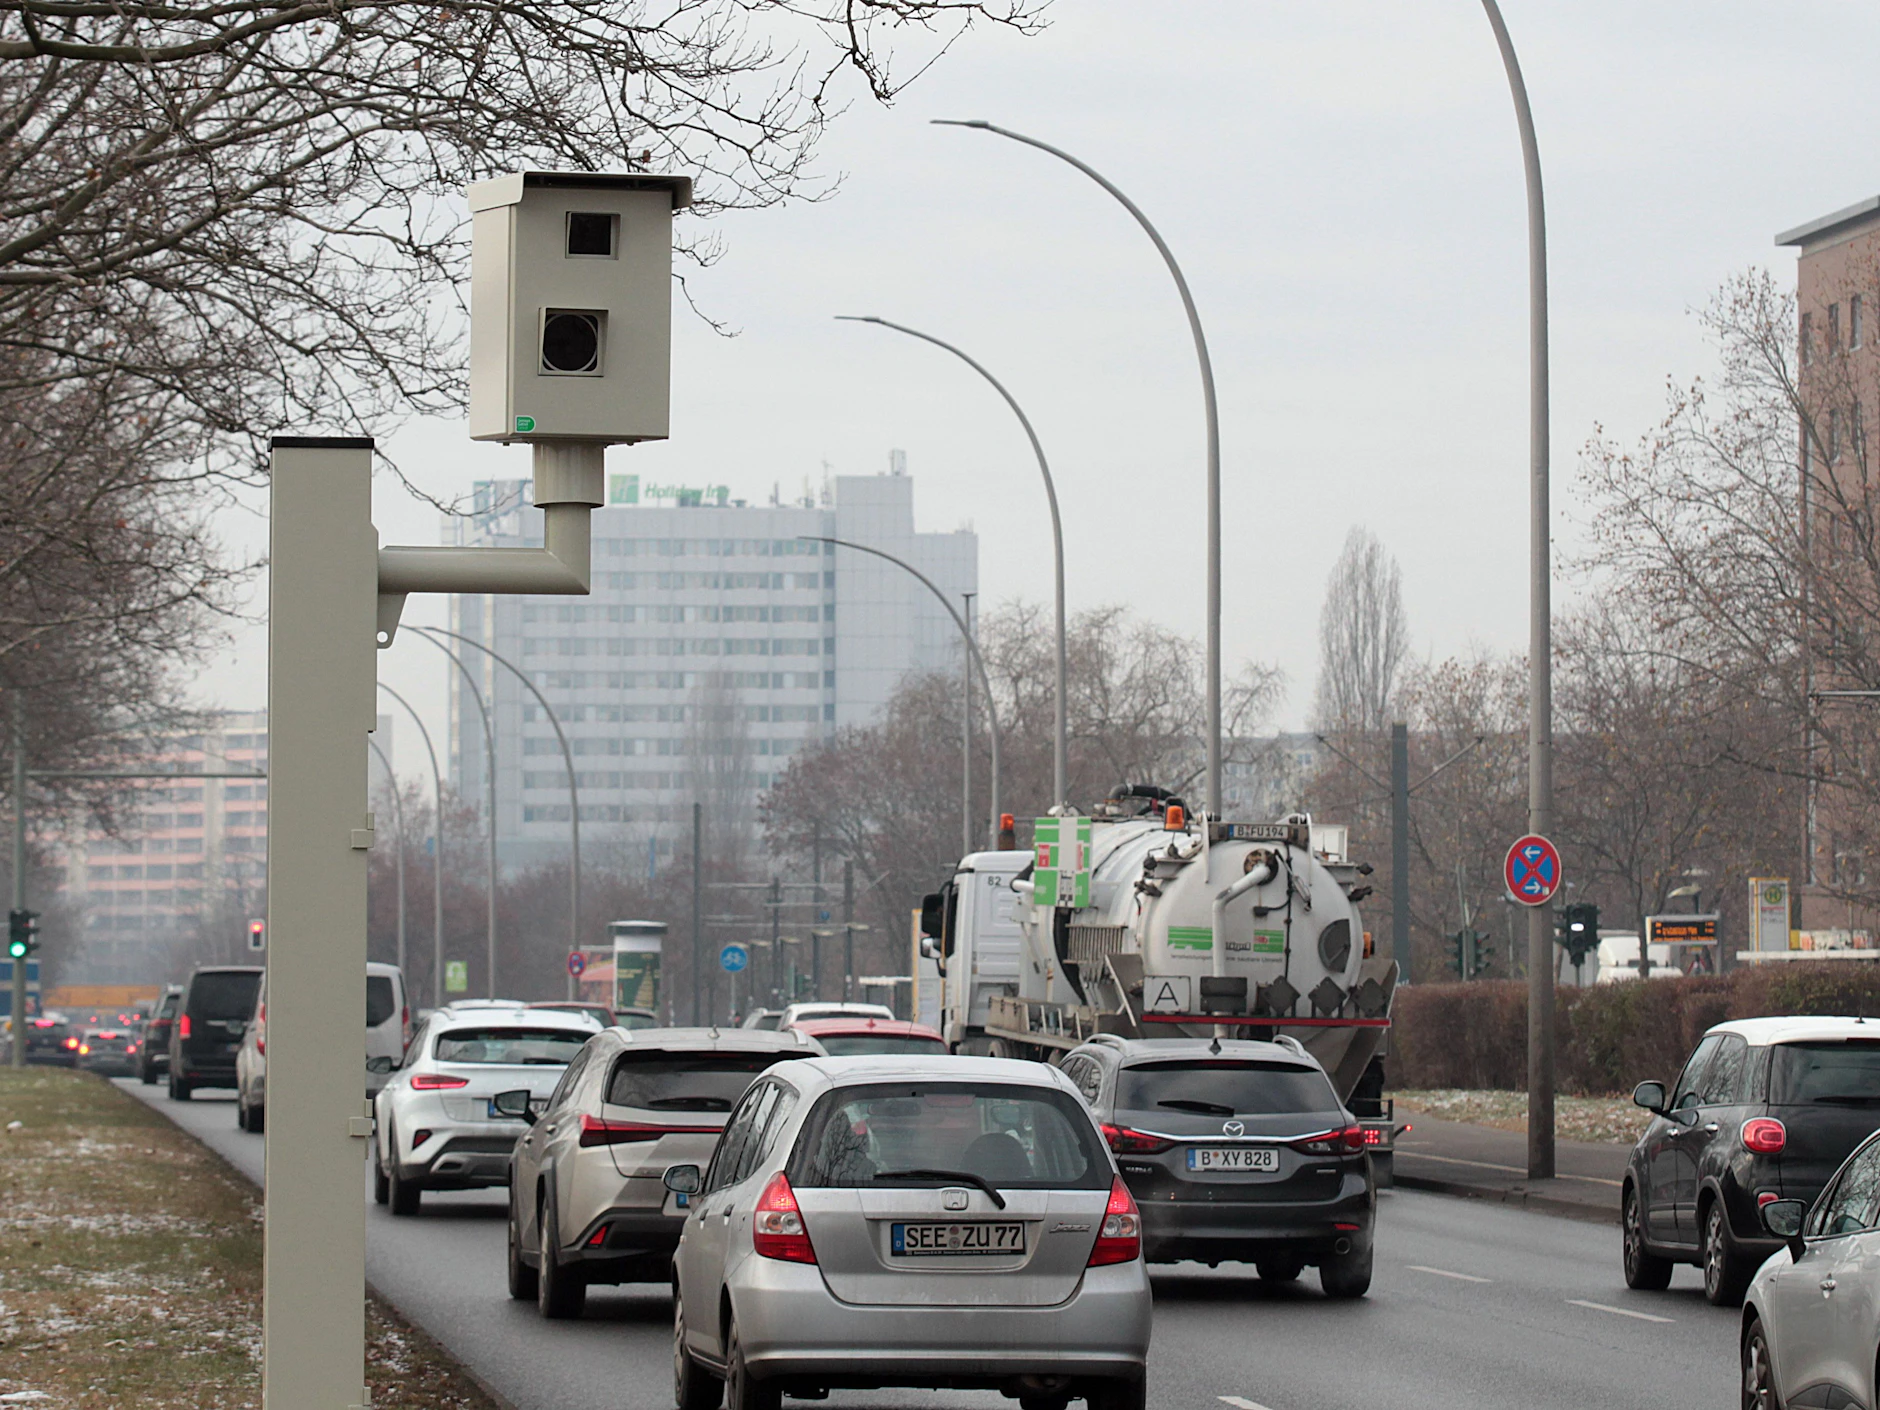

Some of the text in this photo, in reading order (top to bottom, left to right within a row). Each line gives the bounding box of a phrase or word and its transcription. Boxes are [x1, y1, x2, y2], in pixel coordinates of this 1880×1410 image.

[1238, 827, 1244, 836] B
[1154, 981, 1179, 1006] A
[1201, 1152, 1272, 1166] B XY 828
[906, 1226, 1021, 1248] SEE ZU 77
